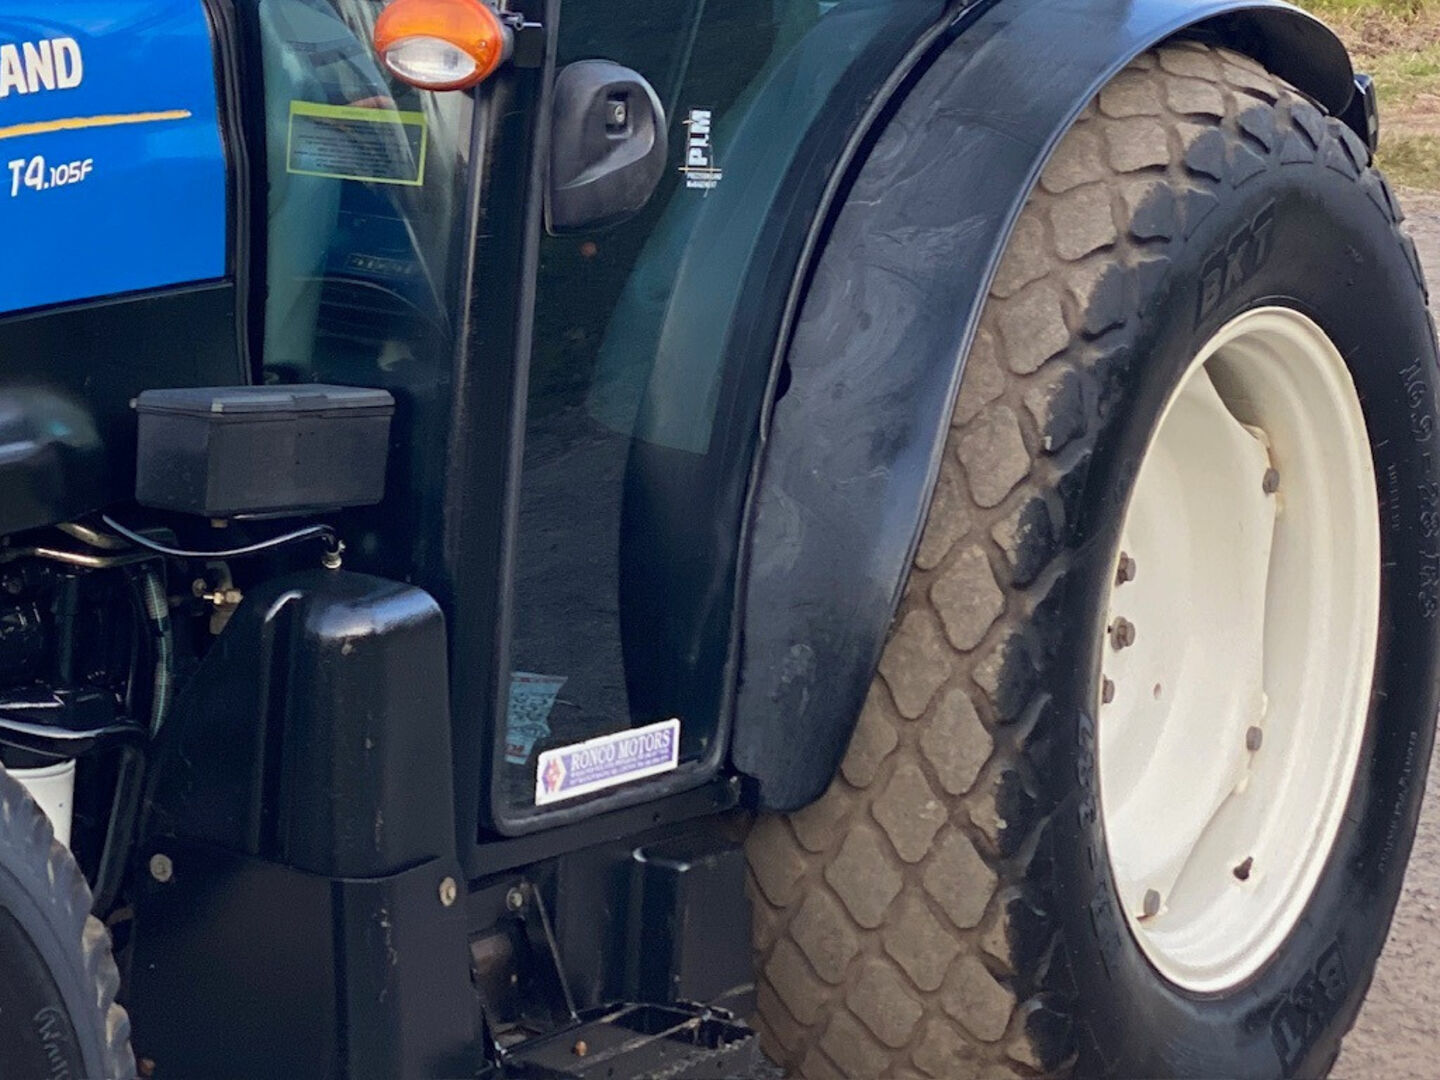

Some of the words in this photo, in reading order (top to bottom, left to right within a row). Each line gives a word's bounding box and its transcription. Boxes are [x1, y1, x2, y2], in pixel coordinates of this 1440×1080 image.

[8, 155, 93, 197] T4.105F
[570, 741, 615, 772] RONCO
[617, 730, 671, 758] MOTORS
